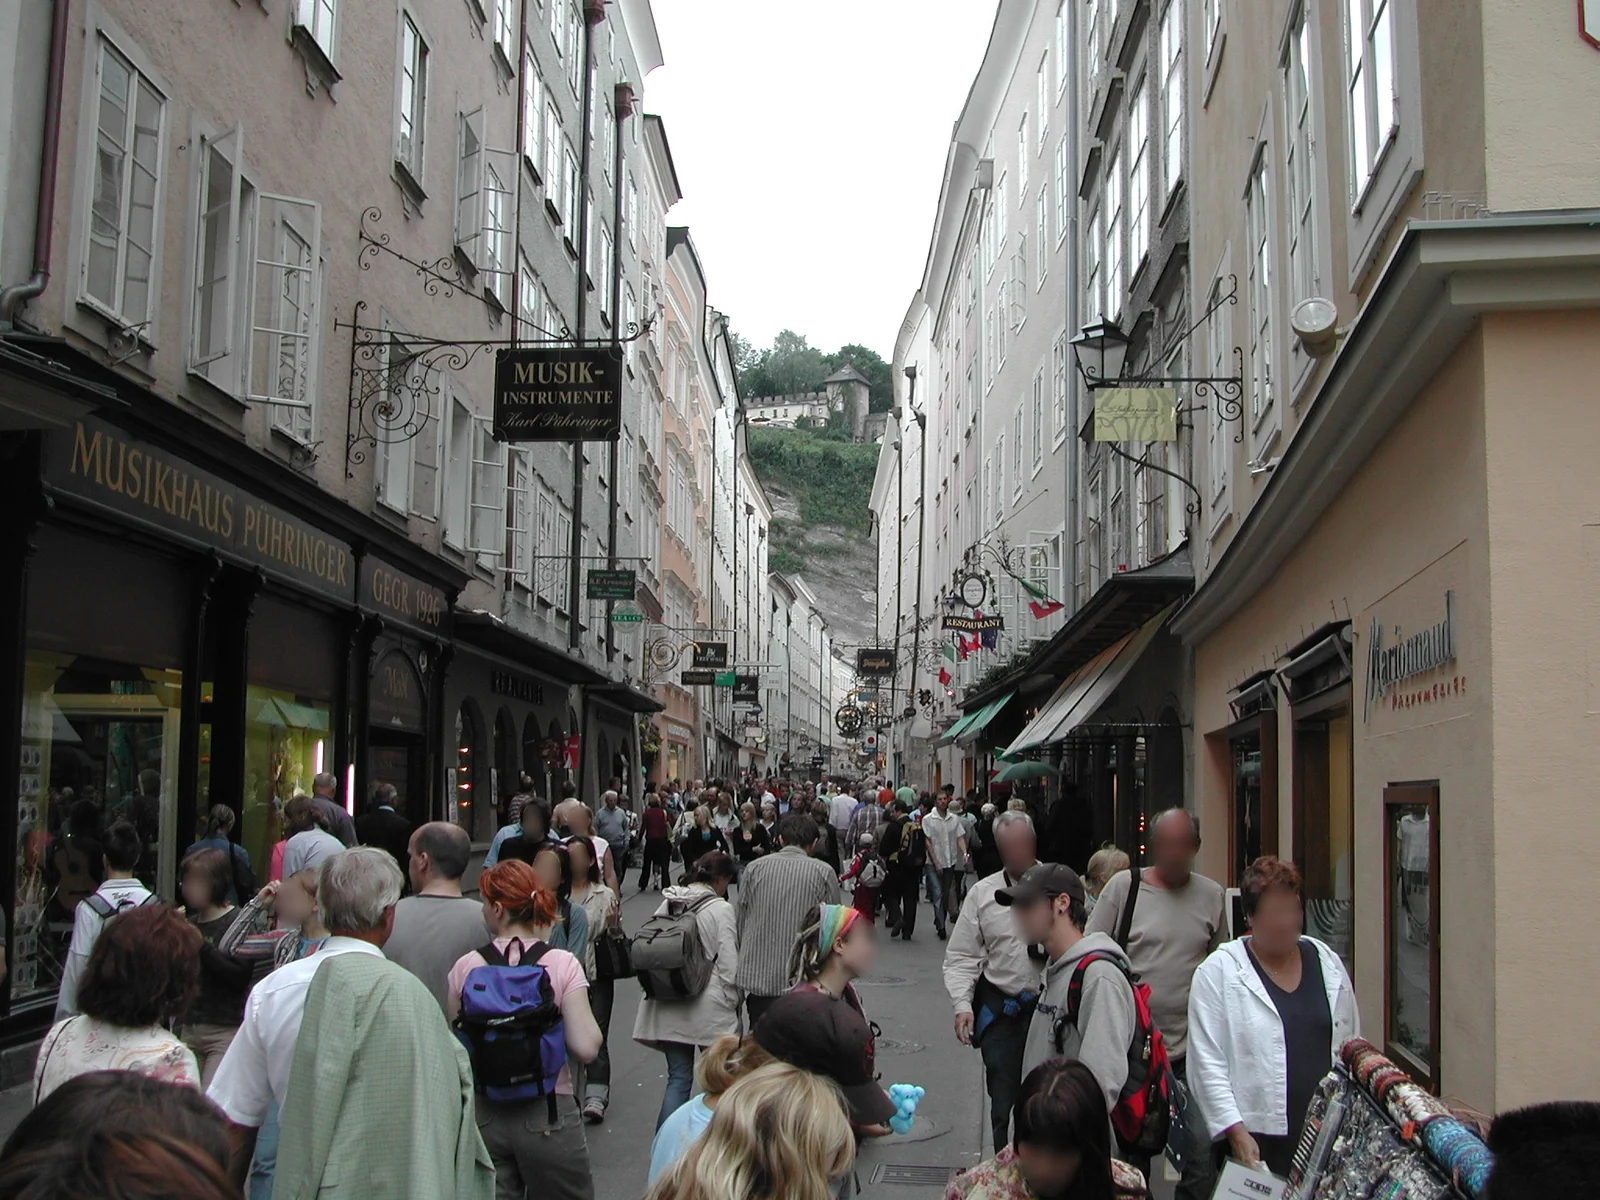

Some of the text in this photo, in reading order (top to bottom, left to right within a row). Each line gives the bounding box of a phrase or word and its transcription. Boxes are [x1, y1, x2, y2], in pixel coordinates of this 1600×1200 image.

[513, 361, 604, 384] MUSIK-
[503, 390, 613, 405] INSTRUMENTE
[502, 411, 612, 431] Karl Pühringer
[69, 421, 347, 587] MUSIKHAUS PÜHRINGER
[372, 568, 440, 627] GEGR. 1926
[946, 618, 1001, 629] RESTAURANT
[1363, 589, 1456, 724] Marionnaud
